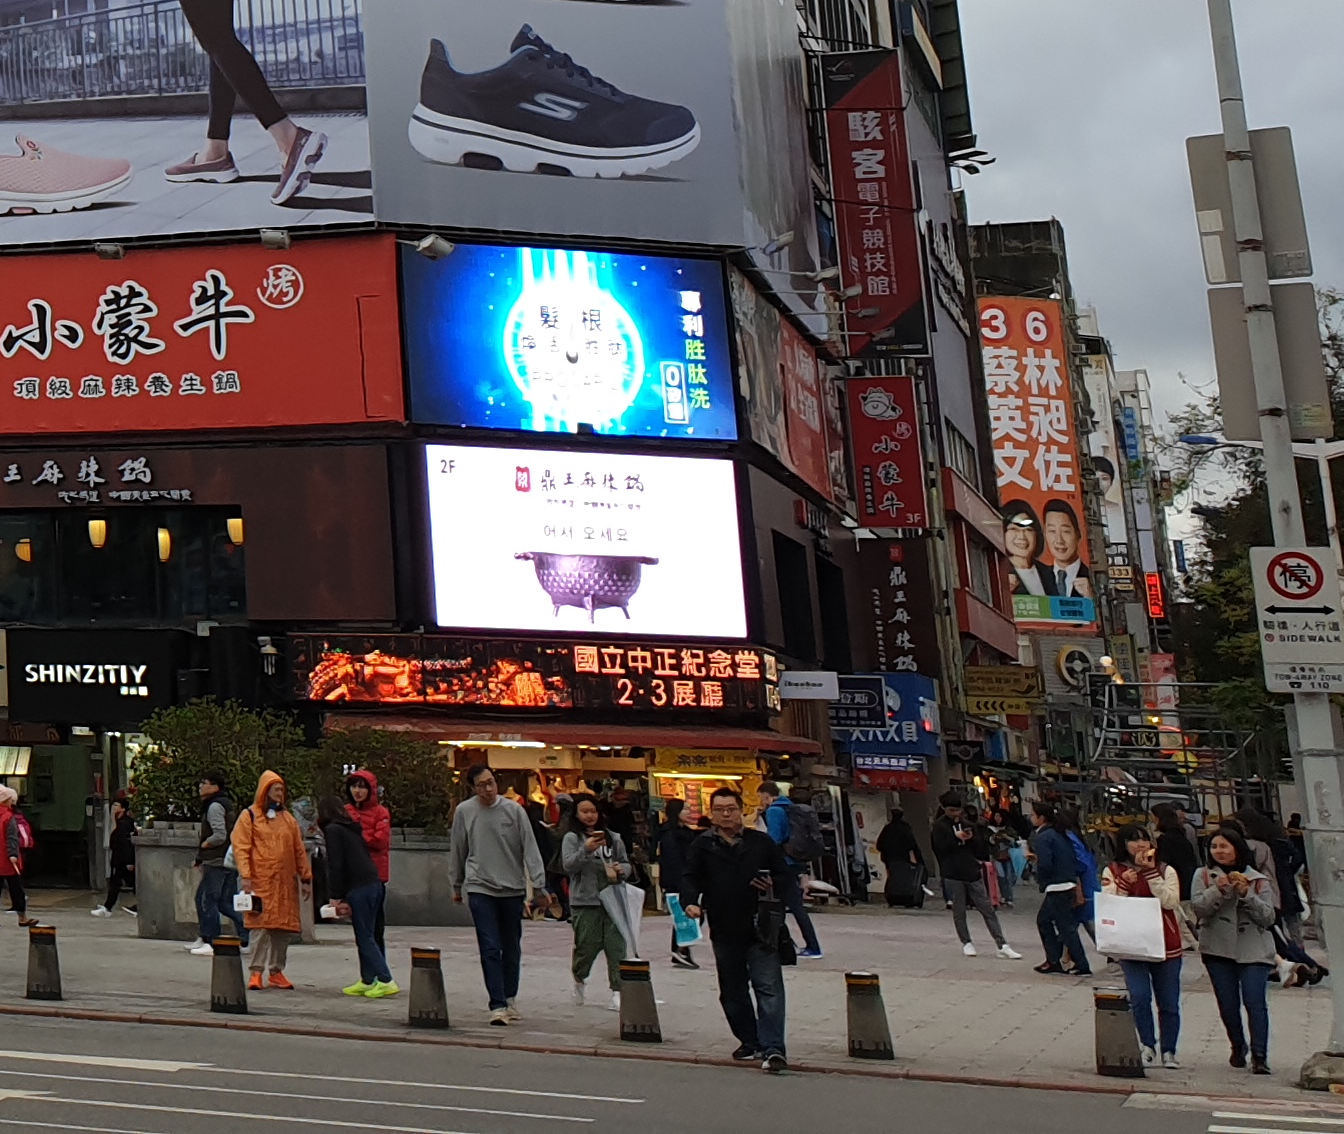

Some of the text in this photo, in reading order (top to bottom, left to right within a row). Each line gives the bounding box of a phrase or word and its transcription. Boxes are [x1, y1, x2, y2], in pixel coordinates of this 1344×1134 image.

[847, 111, 890, 296] 駭客電子競技館
[0, 268, 255, 364] 小蒙牛
[980, 308, 1048, 342] 3 6
[14, 371, 240, 398] 頂級麻辣養生鍋
[983, 346, 1033, 491] 蔡英文
[1023, 347, 1076, 493] 林昶佐
[441, 459, 455, 474] 2F
[871, 435, 905, 518] 小蒙牛
[573, 644, 763, 680] 國立中正紀念堂
[1278, 634, 1342, 643] SIDEWALK
